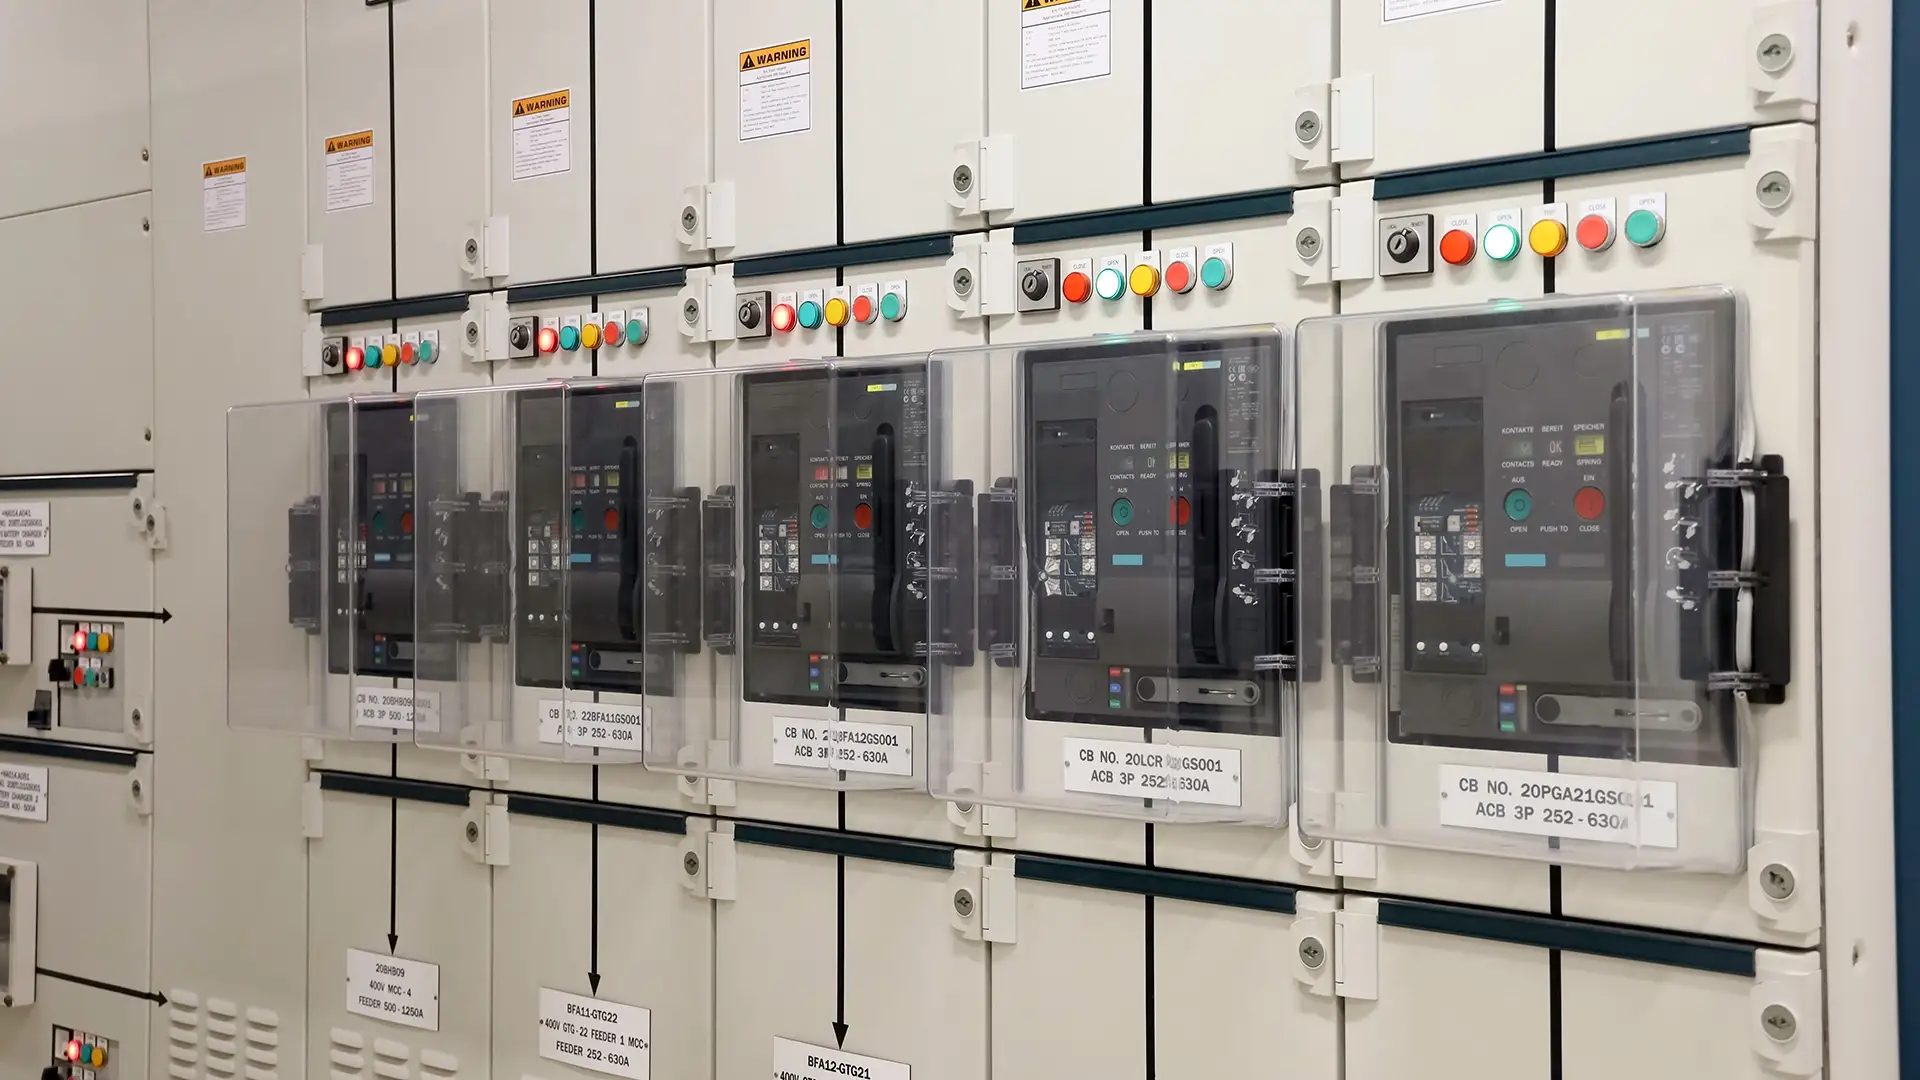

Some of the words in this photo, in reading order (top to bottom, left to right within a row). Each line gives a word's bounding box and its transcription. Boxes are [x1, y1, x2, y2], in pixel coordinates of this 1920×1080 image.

[756, 47, 806, 64] WARNING
[526, 96, 567, 112] WARNING
[336, 136, 371, 150] WARNING
[214, 162, 244, 174] WARNING
[1588, 203, 1606, 212] CLOSE
[1502, 426, 1534, 434] KONTAKTE
[1549, 440, 1562, 453] OK
[357, 694, 366, 703] CB
[369, 695, 379, 704] NO.
[363, 709, 375, 718] ACB
[378, 710, 386, 719] 3P
[549, 709, 559, 719] CB
[582, 711, 641, 725] 22BFA11GS001
[578, 726, 587, 736] 3P
[785, 727, 797, 738] CB
[802, 728, 818, 740] NO.
[822, 730, 898, 746] 2BFA12GS001
[794, 746, 813, 757] ACB
[1079, 749, 1094, 762] CB
[1100, 751, 1119, 764] NO.
[1125, 753, 1223, 773] 20LCRGS001
[1091, 770, 1113, 783] ACB
[1120, 773, 1135, 785] 3P
[1459, 778, 1478, 792] CB
[1487, 780, 1512, 796] NO.
[1476, 802, 1506, 817] ACB
[1514, 806, 1534, 820] 3P
[376, 963, 405, 977] 20BHB09
[369, 980, 385, 991] 400V
[359, 996, 380, 1008] FEEDER
[567, 1003, 618, 1023] BFA11-GTG22
[545, 1018, 560, 1030] 400V
[591, 1029, 616, 1043] FEEDER
[620, 1035, 624, 1045] 1
[628, 1037, 644, 1049] MCC
[556, 1040, 583, 1056] FEEDER
[808, 1055, 870, 1079] BFA12-GTG21
